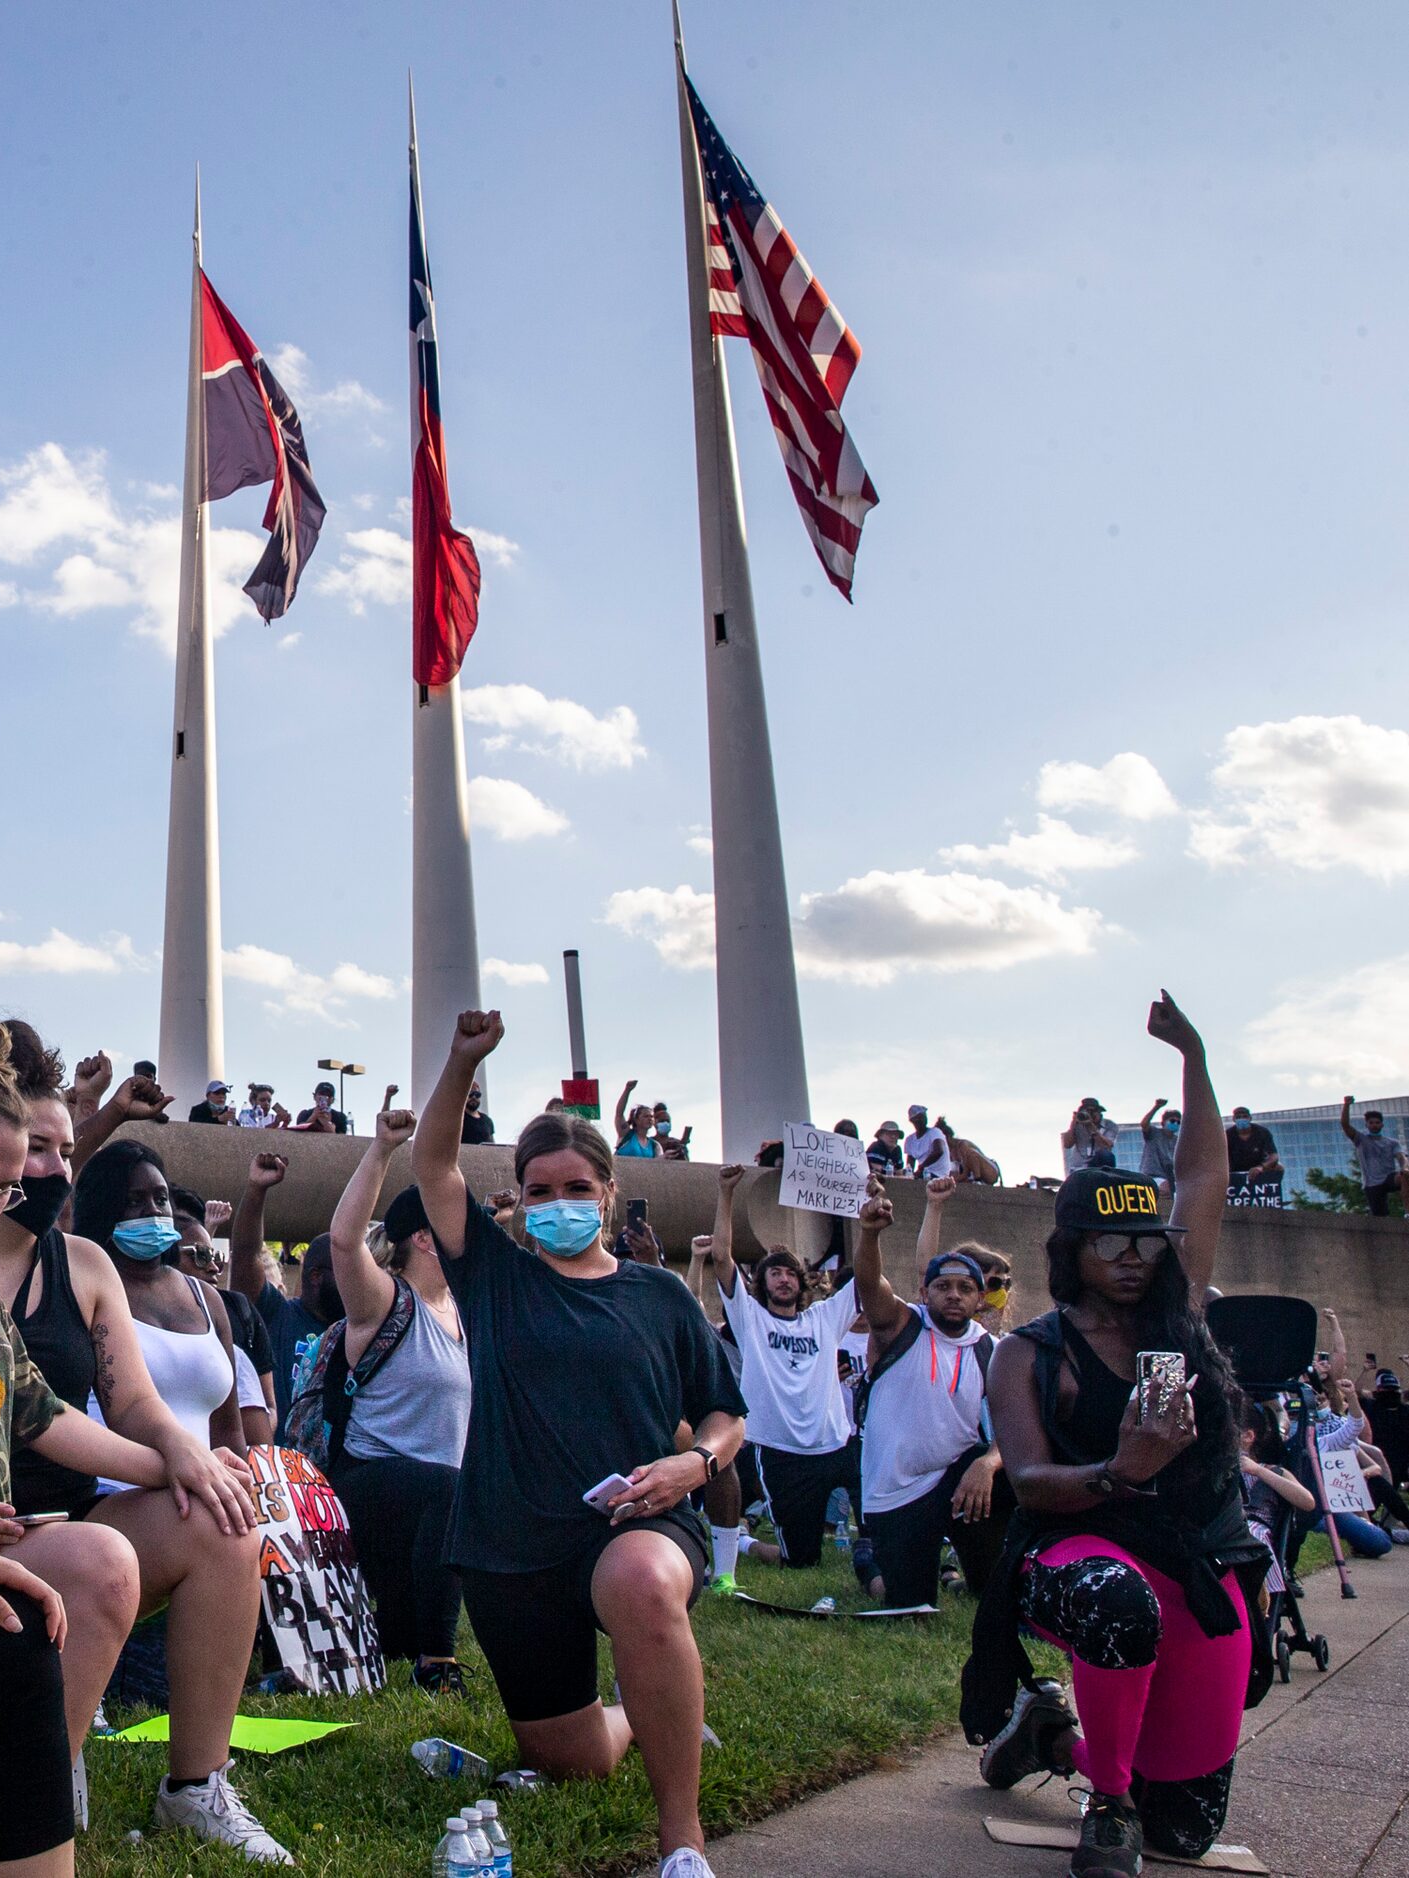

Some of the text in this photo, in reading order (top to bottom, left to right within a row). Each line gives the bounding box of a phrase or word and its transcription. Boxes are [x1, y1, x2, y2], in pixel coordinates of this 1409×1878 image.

[790, 1128, 835, 1154] LOVE
[796, 1152, 860, 1180] NEIGHBOR
[787, 1169, 865, 1197] AS YOURSELF
[1226, 1183, 1279, 1197] CAN'T
[796, 1189, 860, 1215] MARK 12:31
[1095, 1184, 1158, 1216] QUEEN
[768, 1331, 820, 1356] COWBOYS
[252, 1481, 345, 1533] IS NOT
[1329, 1492, 1365, 1511] city
[260, 1534, 295, 1579] A
[266, 1567, 371, 1629] BLACK
